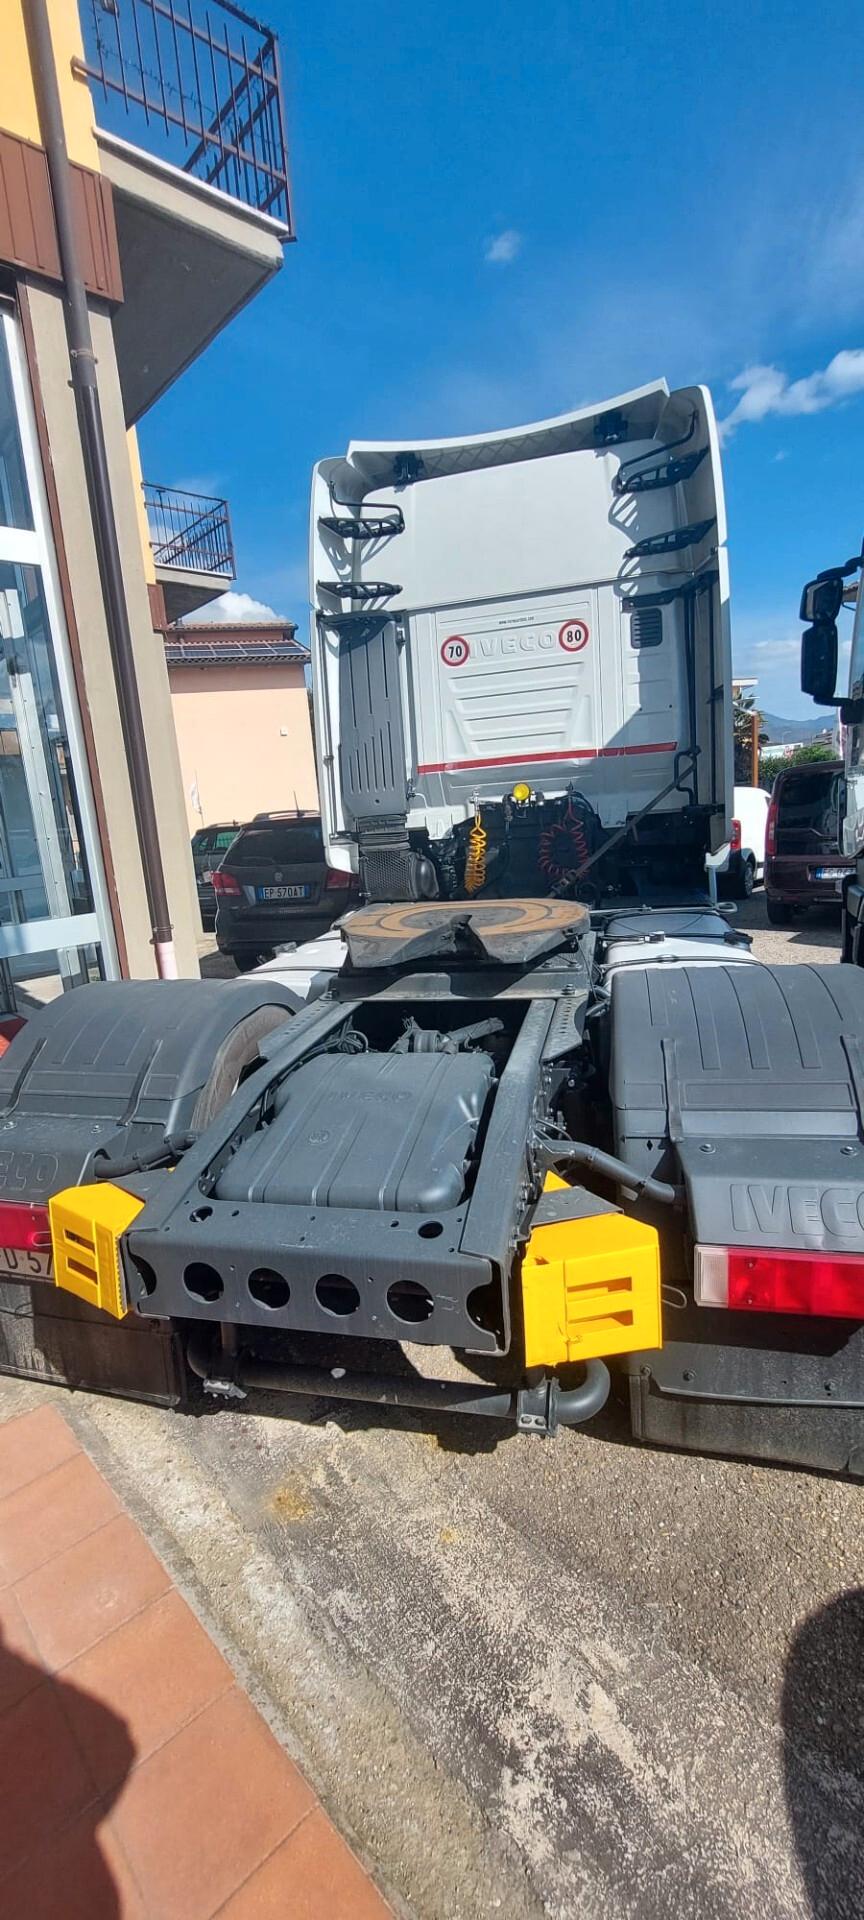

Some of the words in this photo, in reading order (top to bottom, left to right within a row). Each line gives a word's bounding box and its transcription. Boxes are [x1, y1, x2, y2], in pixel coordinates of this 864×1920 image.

[469, 631, 555, 659] IVECO
[566, 629, 582, 643] 80
[448, 645, 463, 658] 70
[730, 1183, 864, 1238] IVEC
